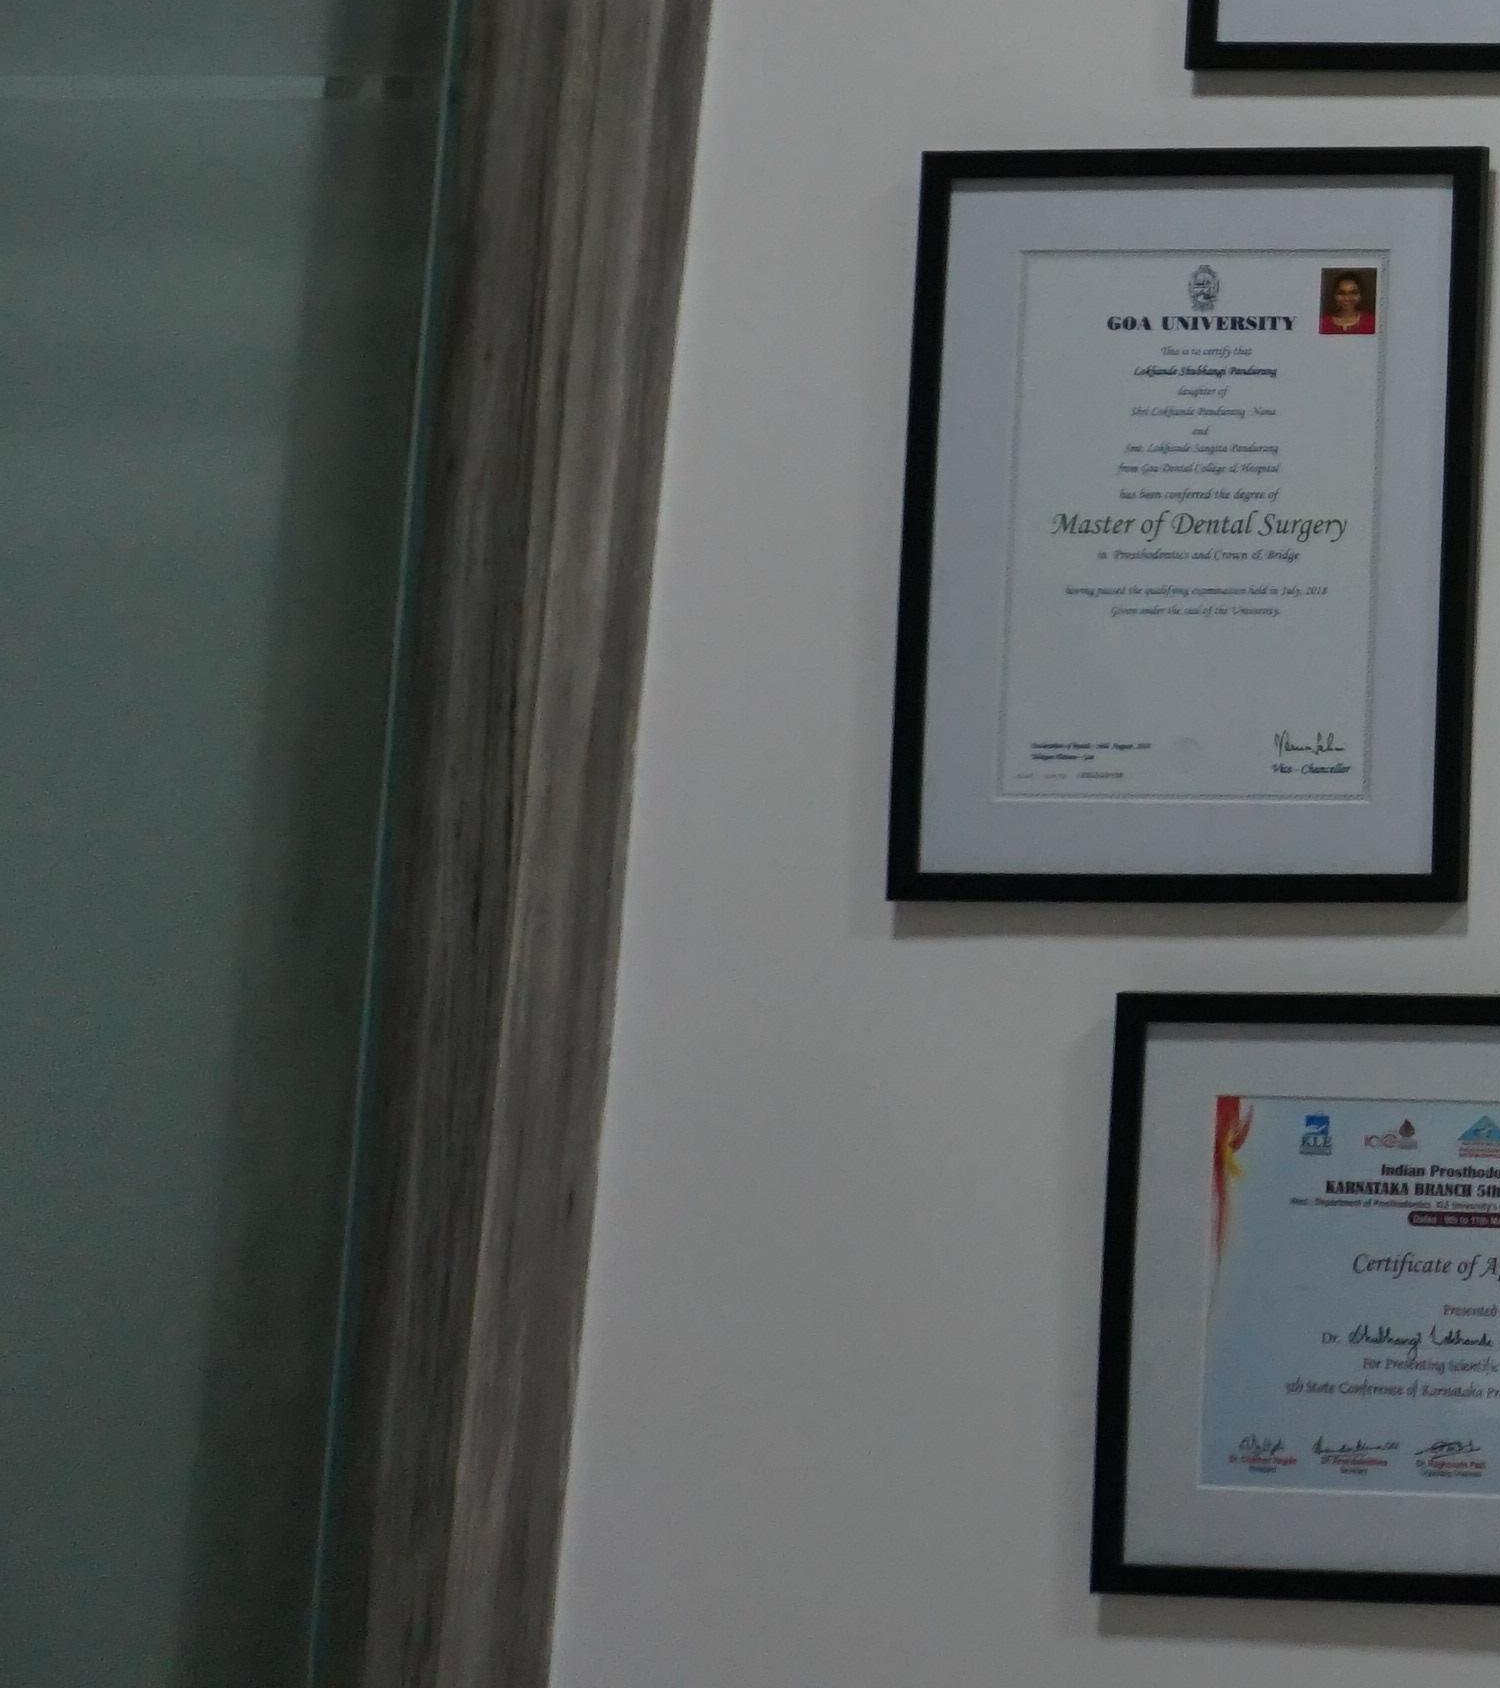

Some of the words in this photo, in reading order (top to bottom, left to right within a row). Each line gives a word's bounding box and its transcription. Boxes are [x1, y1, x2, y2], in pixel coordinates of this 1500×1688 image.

[1106, 315, 1152, 331] GOA
[1161, 315, 1296, 331] UNIVERSITY
[1050, 512, 1137, 535] Master
[1139, 509, 1171, 543] of
[1171, 509, 1256, 536] Dental
[1257, 511, 1348, 543] Surgery
[1380, 1163, 1426, 1178] Indian
[1352, 1252, 1453, 1278] Certificate
[1456, 1254, 1479, 1278] of
